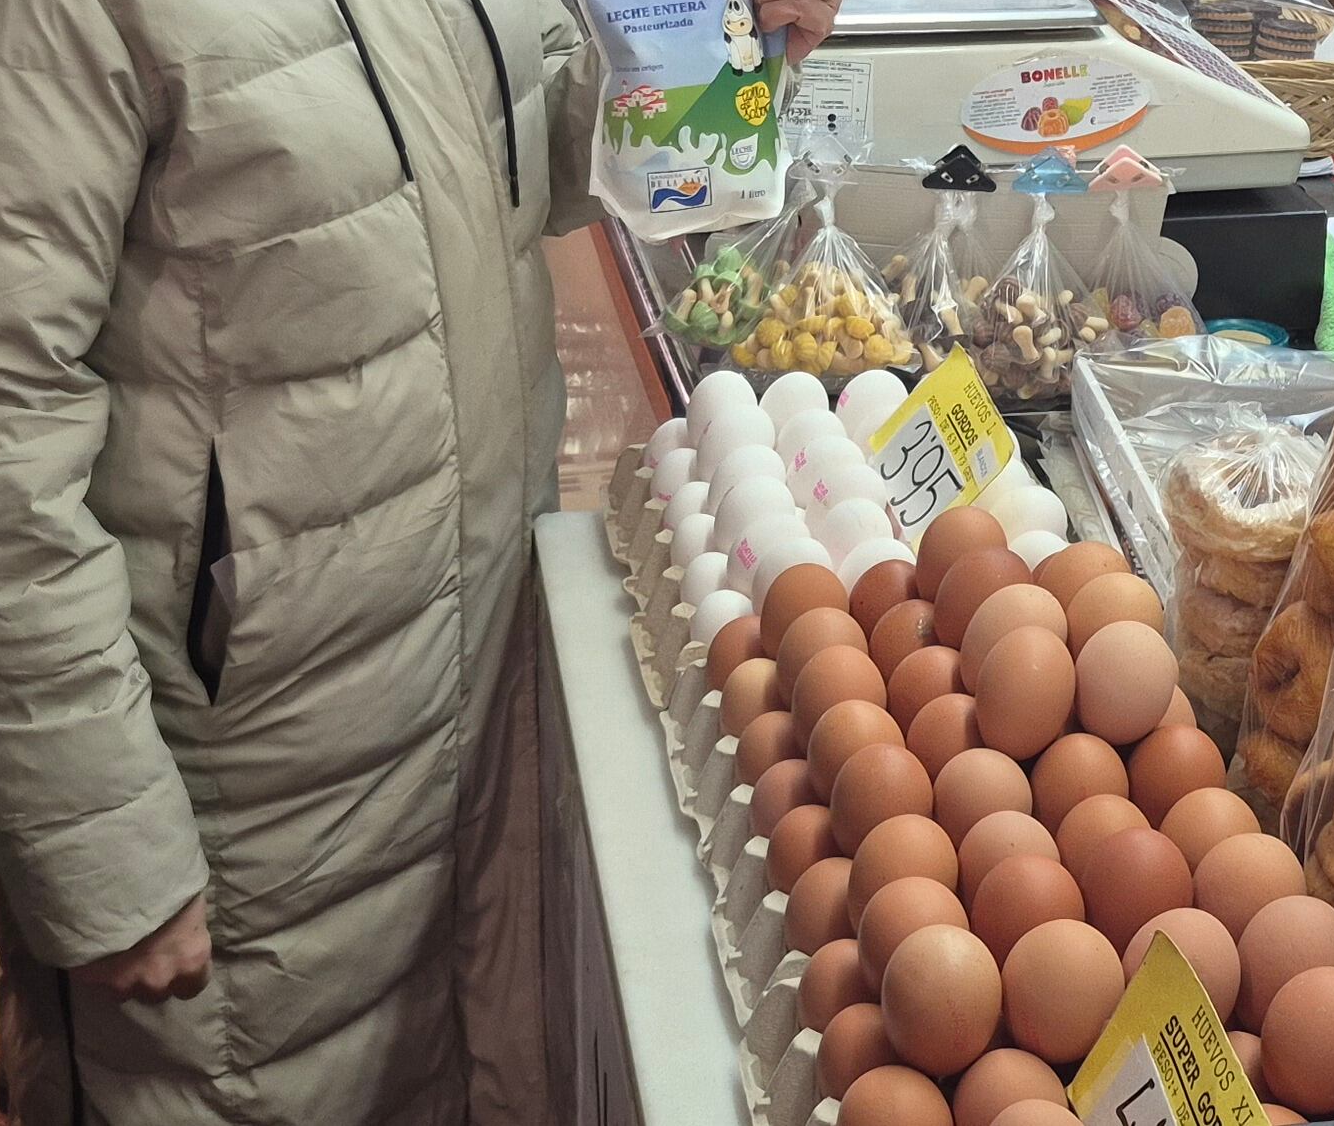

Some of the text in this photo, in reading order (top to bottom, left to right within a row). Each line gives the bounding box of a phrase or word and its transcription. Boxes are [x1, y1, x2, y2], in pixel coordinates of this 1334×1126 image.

[608, 0, 707, 23] LECHE ENTERA
[623, 17, 694, 34] Pasteurizada
[963, 380, 992, 424] HUEVOS
[946, 432, 957, 446] 63
[951, 403, 979, 446] GORDOS
[880, 420, 965, 528] 3'95
[1165, 1015, 1201, 1091] SUPER
[1191, 1005, 1235, 1092] HUEVOS
[1176, 1102, 1190, 1124] DE
